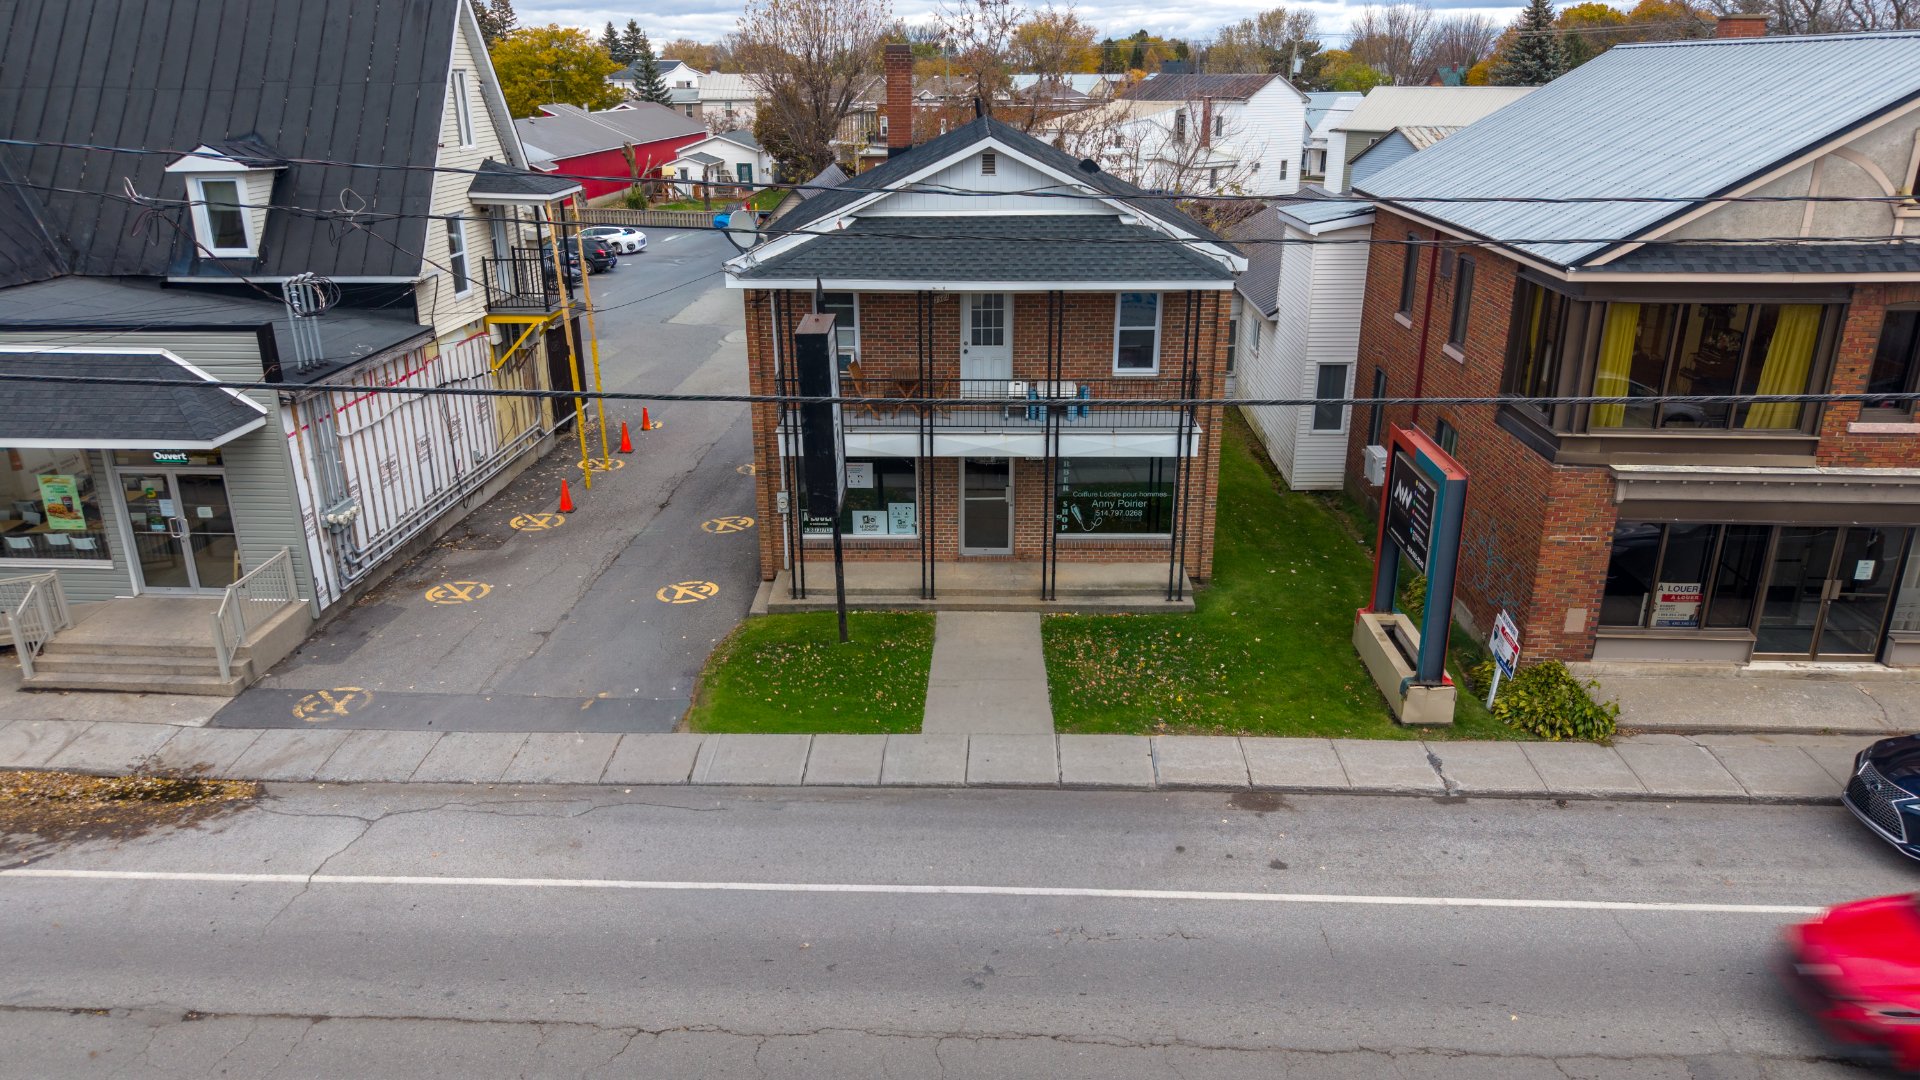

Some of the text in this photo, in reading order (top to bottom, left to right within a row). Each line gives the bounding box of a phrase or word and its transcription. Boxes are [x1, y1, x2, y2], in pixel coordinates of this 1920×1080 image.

[153, 452, 187, 460] Ouvert
[1092, 500, 1115, 509] Anny
[1061, 501, 1069, 530] SHOP
